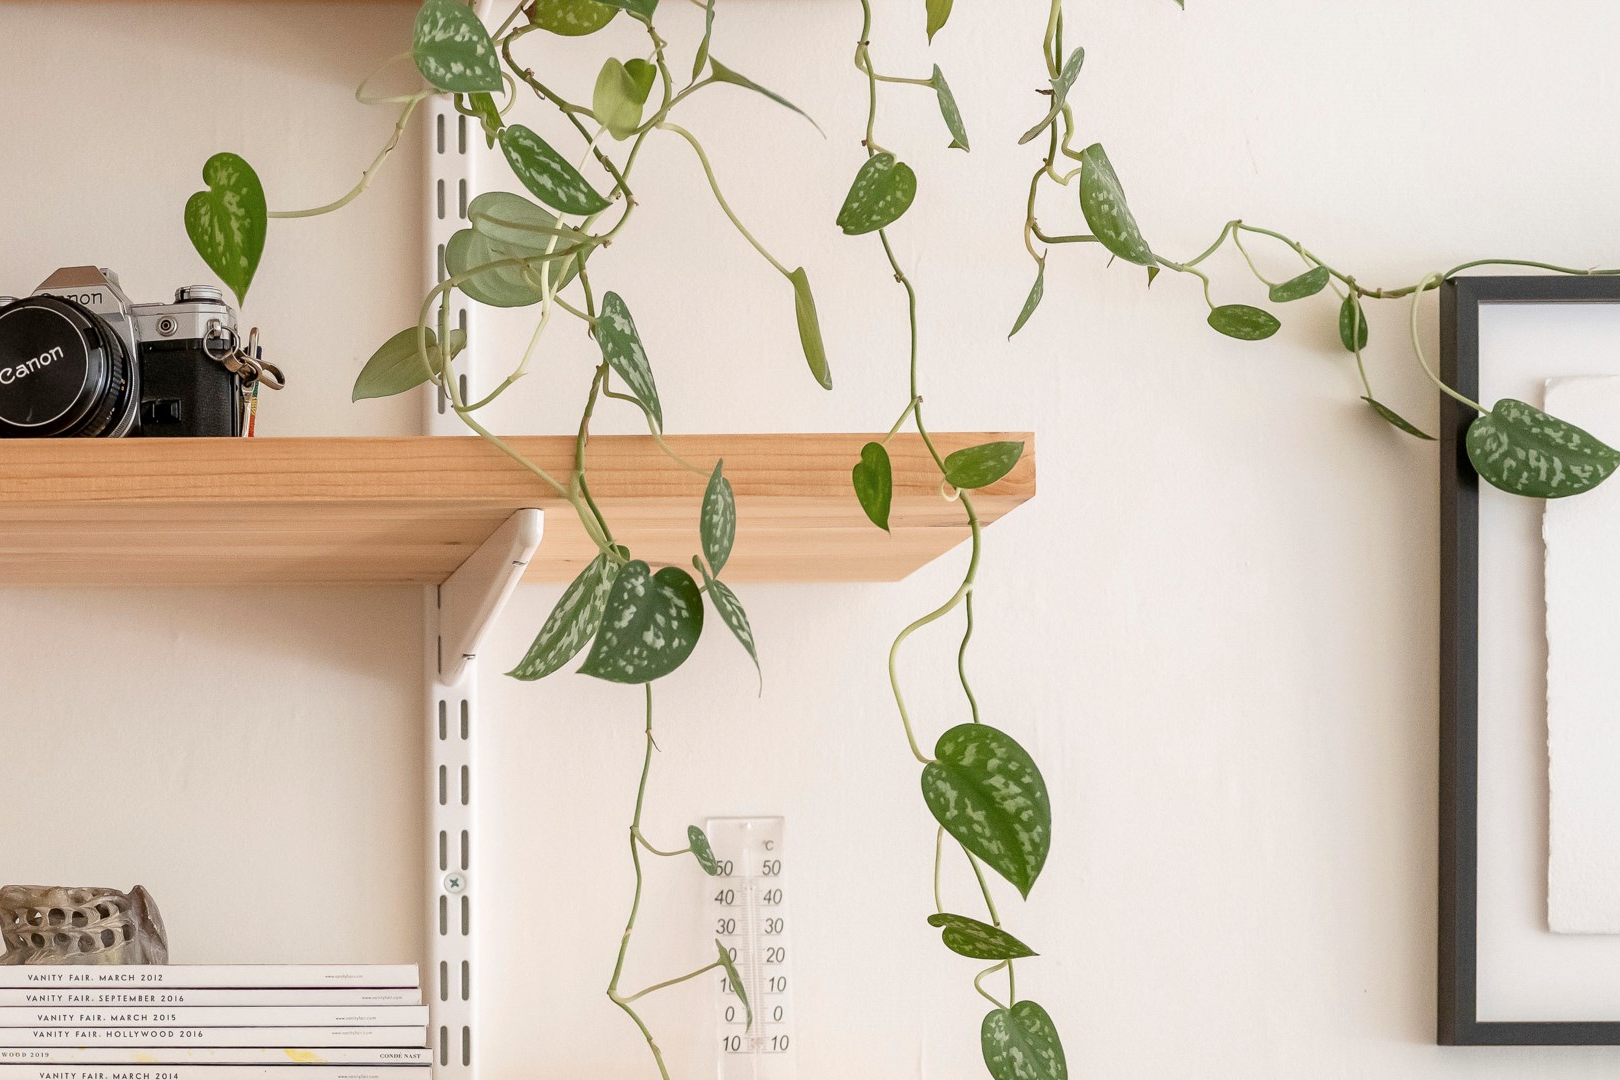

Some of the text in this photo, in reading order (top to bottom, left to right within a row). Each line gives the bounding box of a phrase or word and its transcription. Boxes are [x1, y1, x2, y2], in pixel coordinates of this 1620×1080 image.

[716, 860, 781, 876] 50 50
[715, 889, 783, 905] 40 40
[716, 918, 784, 934] 30 30
[766, 947, 785, 963] 20
[28, 974, 163, 982] VANITY FAIR. MARCH 2012
[37, 1014, 177, 1022] VANITY FAIR. MARCH 2015
[725, 1006, 783, 1022] 0 0
[33, 1030, 203, 1038] VANITY FAIR. HOLLYWOOD 2016
[722, 1035, 789, 1051] 10 10
[39, 1072, 179, 1080] VANITY FAIR. MARCH 2014
